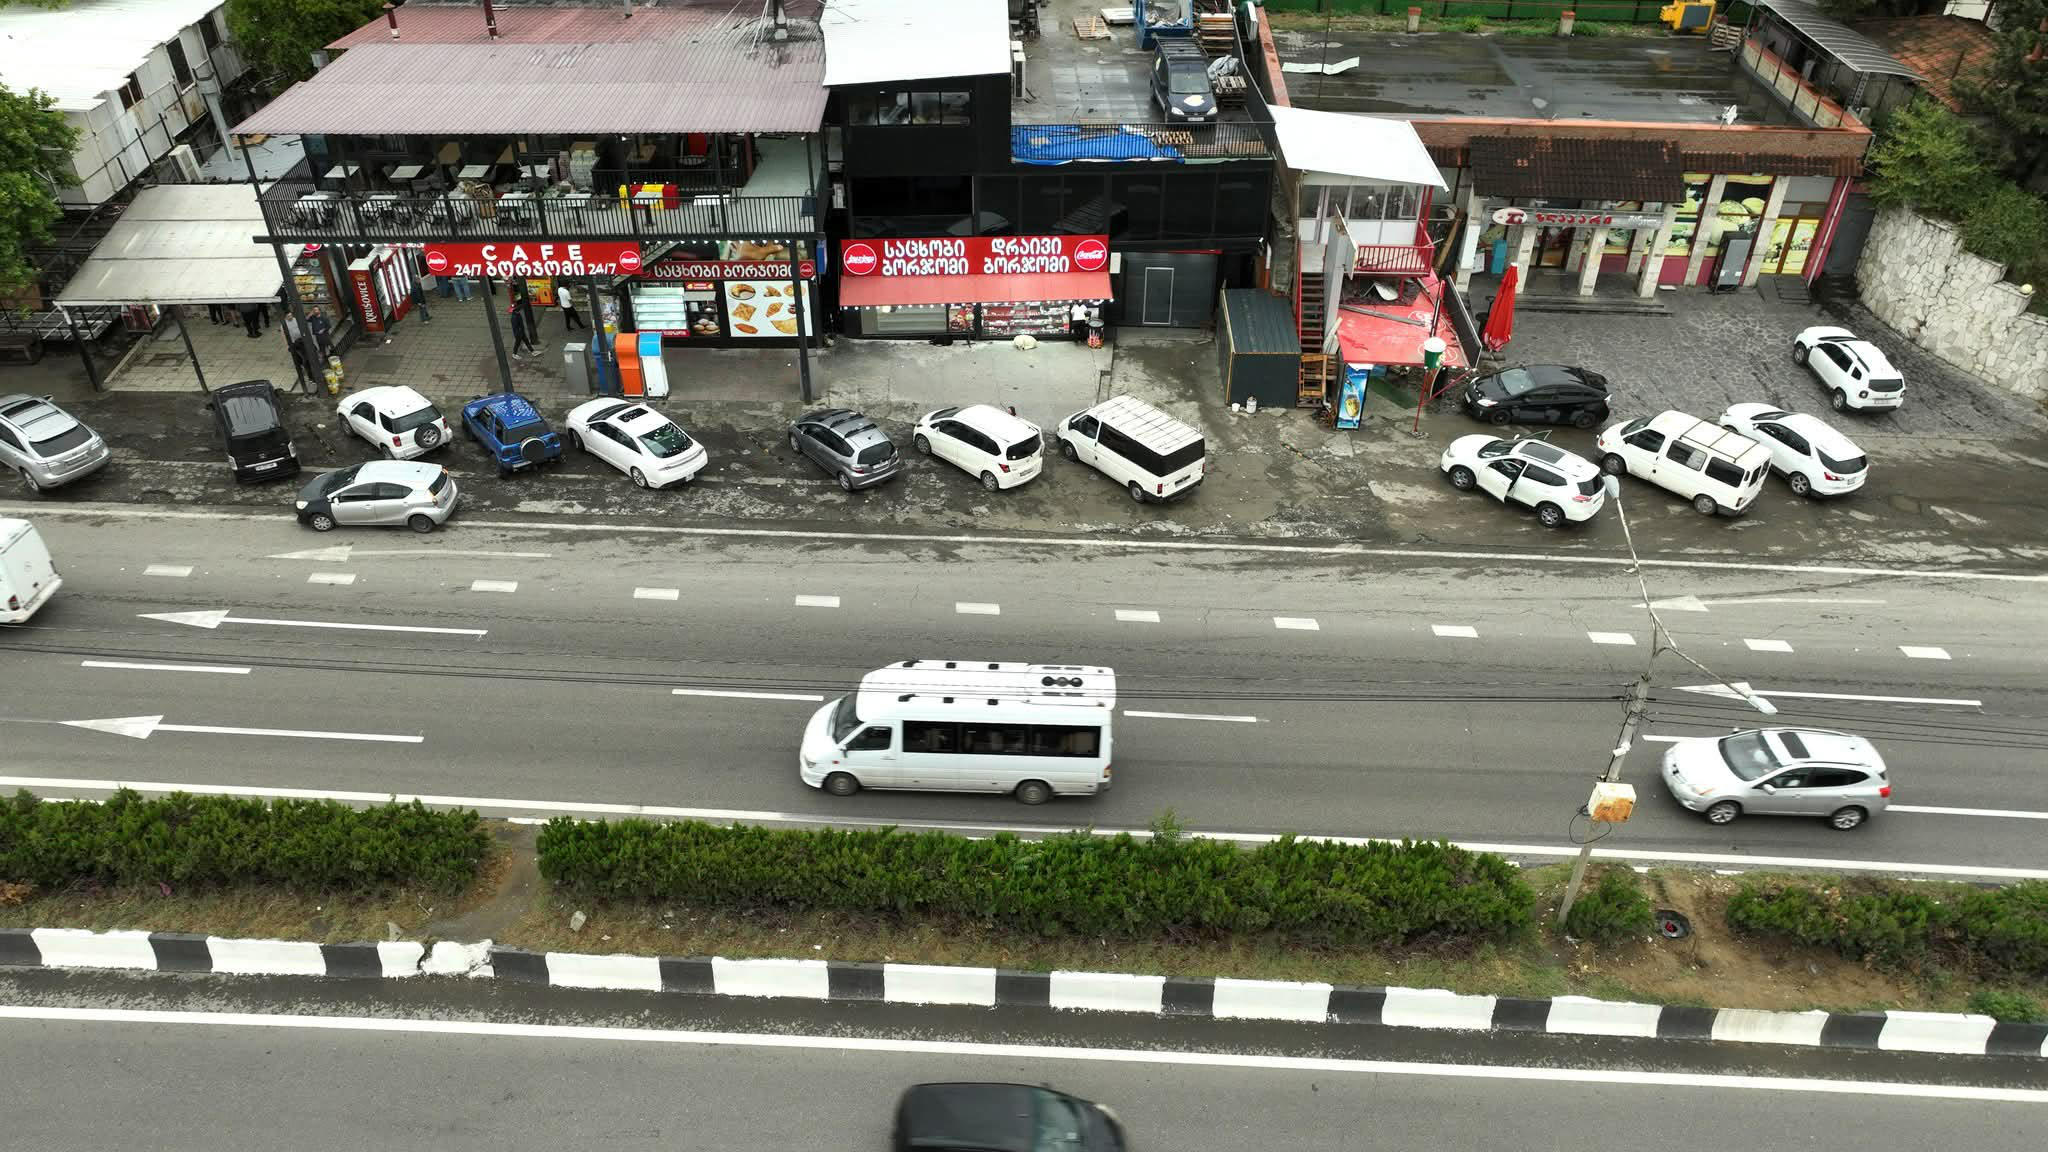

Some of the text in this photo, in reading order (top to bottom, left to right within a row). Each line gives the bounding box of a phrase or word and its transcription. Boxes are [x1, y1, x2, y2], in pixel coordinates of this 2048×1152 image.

[481, 245, 583, 261] CAFE
[884, 239, 965, 258] საცხობი
[991, 237, 1062, 256] დრაივი
[454, 260, 617, 277] 24/7 ბორჯომი 24/7
[654, 264, 721, 279] საცხობი
[882, 258, 969, 276] ბორჯომი
[983, 256, 1070, 274] ბორჯომი
